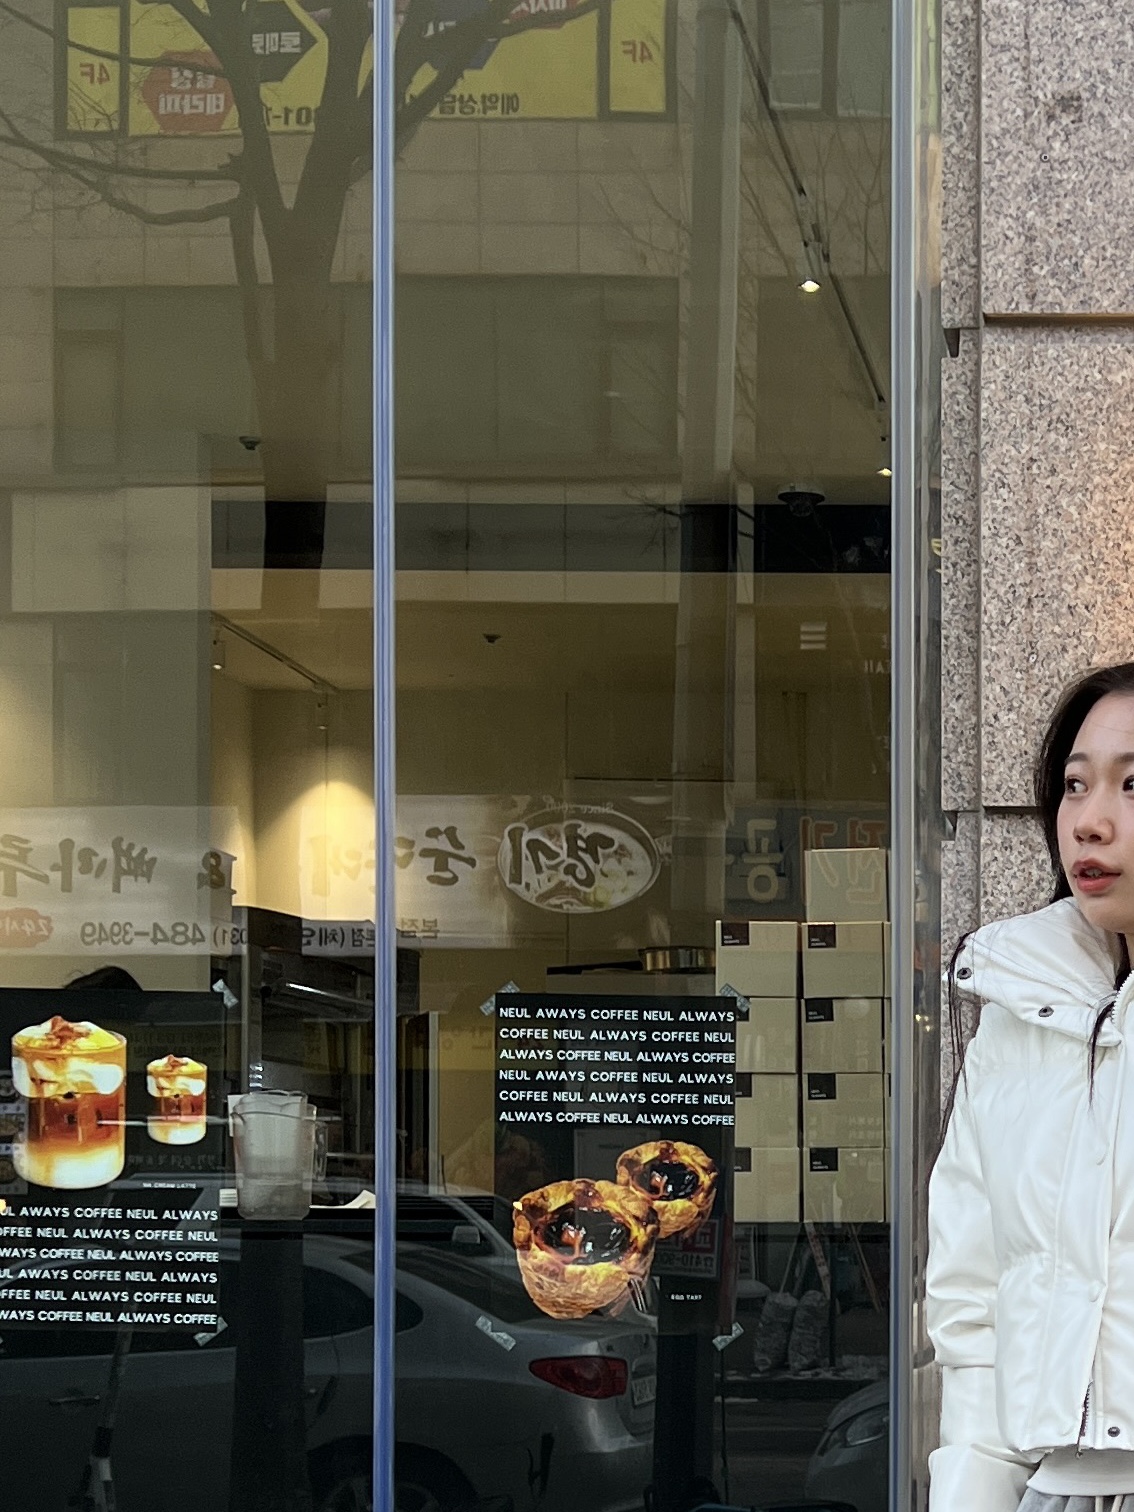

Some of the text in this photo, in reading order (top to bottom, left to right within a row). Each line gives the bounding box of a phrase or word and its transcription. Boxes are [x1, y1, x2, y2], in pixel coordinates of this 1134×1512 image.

[500, 1008, 735, 1022] NEUL AWAYS COFFEE NEUL ALWAYS
[500, 1028, 735, 1043] COFFEE NEUL ALWAYS COFFEE NEUL
[500, 1049, 736, 1064] ALWAYS COFFEE NEUL ALWAYS COFFEE
[500, 1070, 734, 1084] NEUL AWAYS COFFEE NEUL ALWAYS
[500, 1090, 734, 1105] COFFEE NEUL ALWAYS COFFEE NEUL
[500, 1111, 735, 1126] ALWAYS COFFEE NEUL ALWAYS COFFEE
[20, 1206, 69, 1218] AWAYS
[74, 1207, 122, 1219] COFFEE
[127, 1209, 158, 1220] NEUL
[163, 1209, 218, 1221] ALWAYS
[36, 1228, 69, 1239] NEUL
[73, 1228, 131, 1240] ALWAYS
[134, 1230, 184, 1241] COFFEE
[187, 1231, 218, 1242] NEUL
[0, 1247, 219, 1263] WAYS COFFEE NEUL ALWAYS COFFEE
[18, 1268, 69, 1280] AWAYS
[73, 1269, 121, 1281] COFFEE
[125, 1271, 157, 1282] NEUL
[161, 1271, 218, 1283] ALWAYS
[35, 1290, 68, 1301] NEUL
[71, 1290, 129, 1302] ALWAYS
[133, 1291, 182, 1303] COFFEE
[186, 1293, 217, 1304] NEUL
[0, 1310, 217, 1325] WAYS COFFEE NEUL ALWAYS COFFEE
